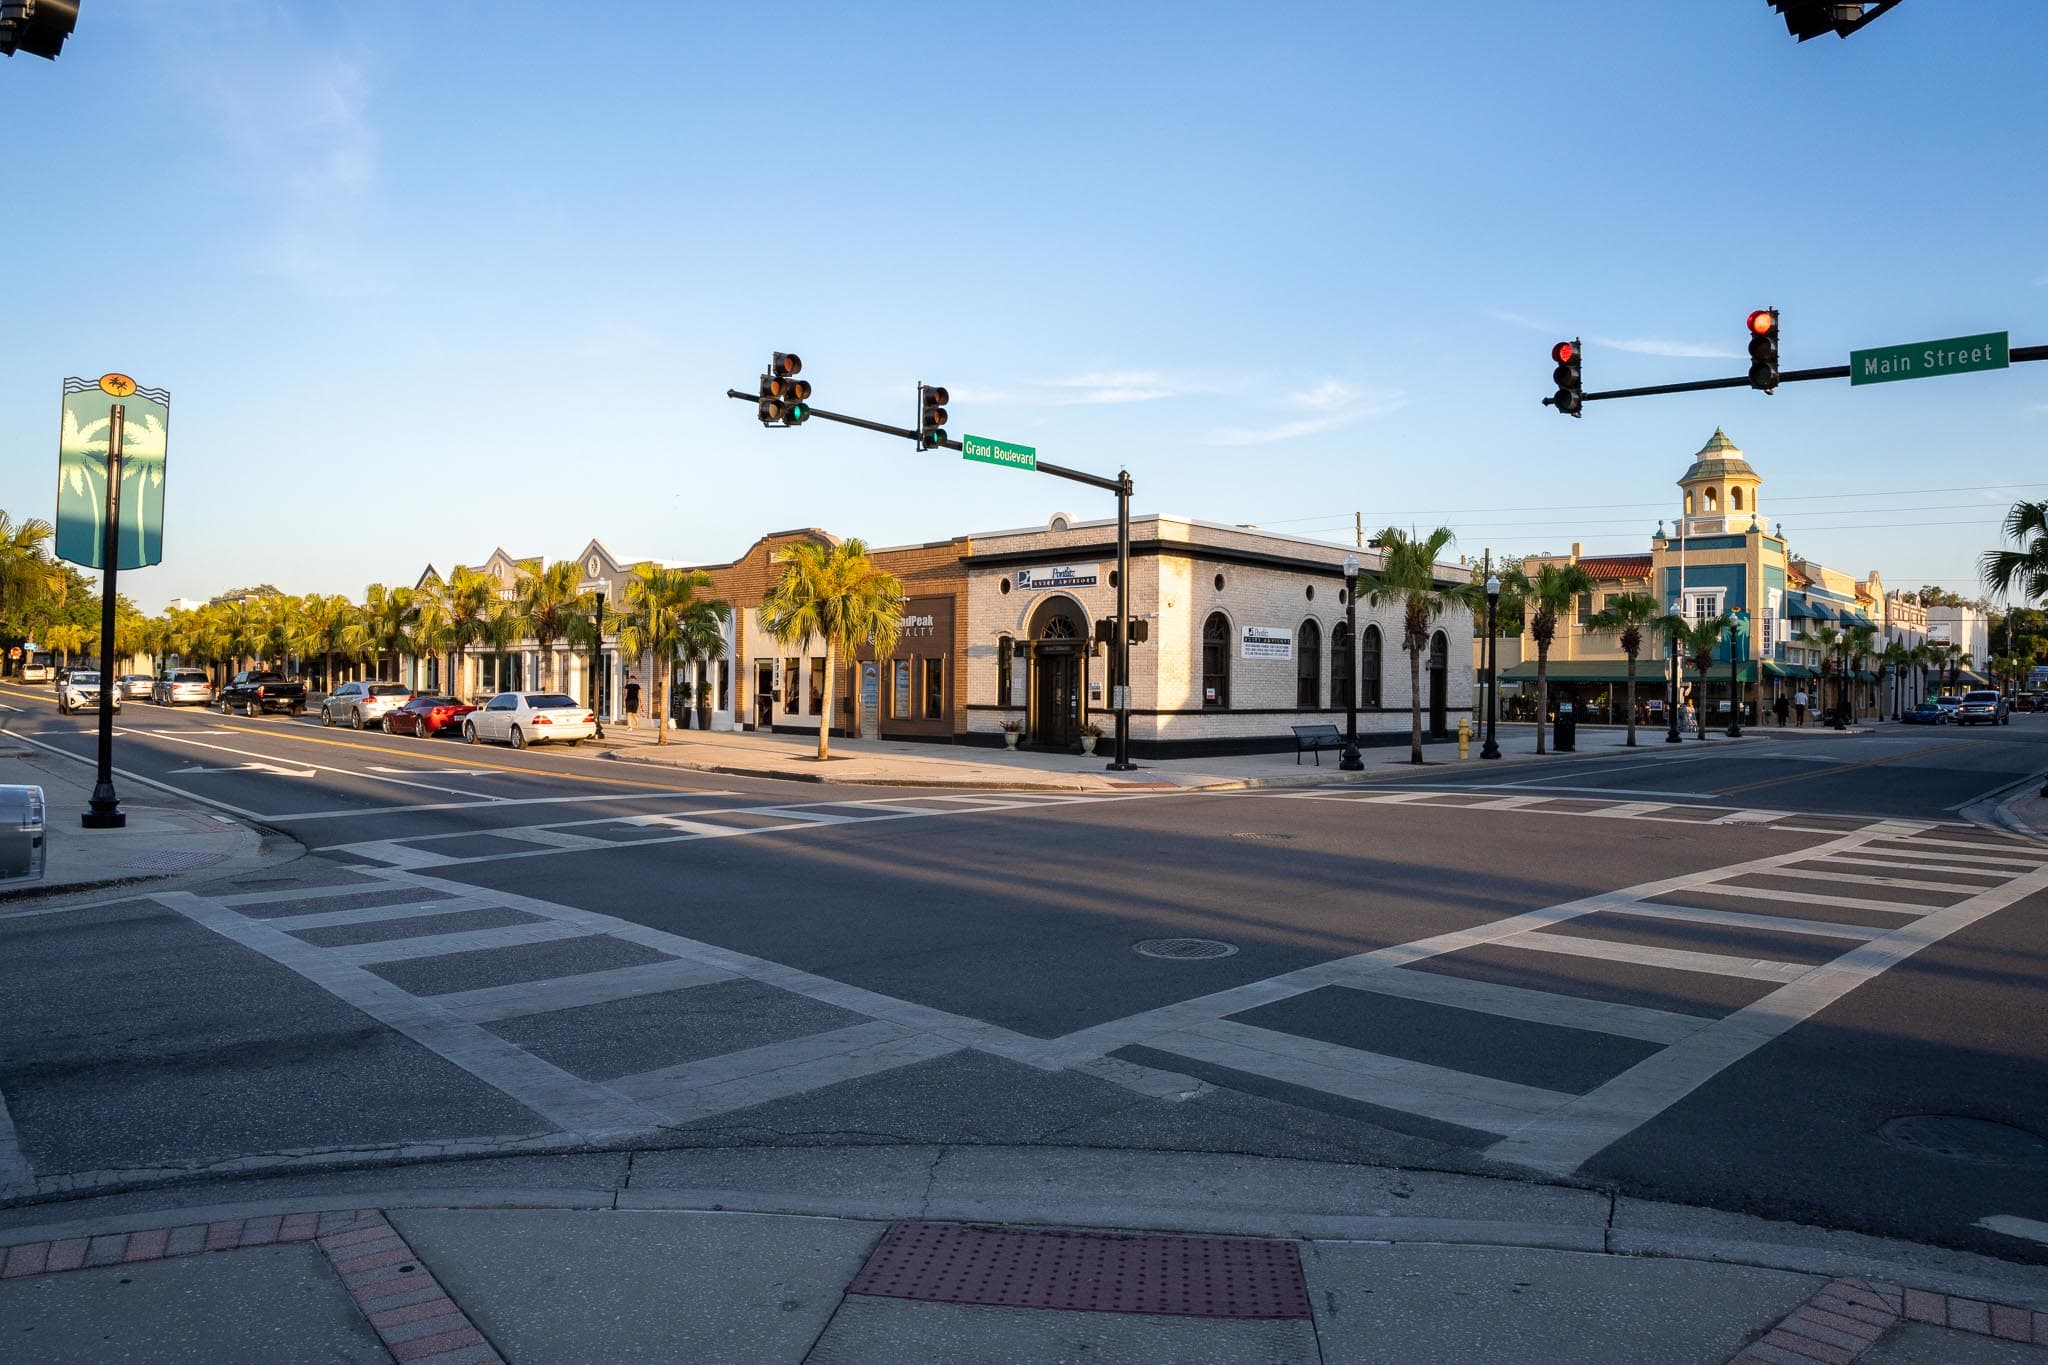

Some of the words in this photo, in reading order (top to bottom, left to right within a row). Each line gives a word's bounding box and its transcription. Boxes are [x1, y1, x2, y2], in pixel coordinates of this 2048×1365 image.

[1864, 355, 1911, 375] Main
[1923, 343, 1992, 368] Street
[965, 441, 991, 458] Grand
[994, 446, 1034, 465] Boulevard
[1058, 577, 1096, 585] ADVISORS
